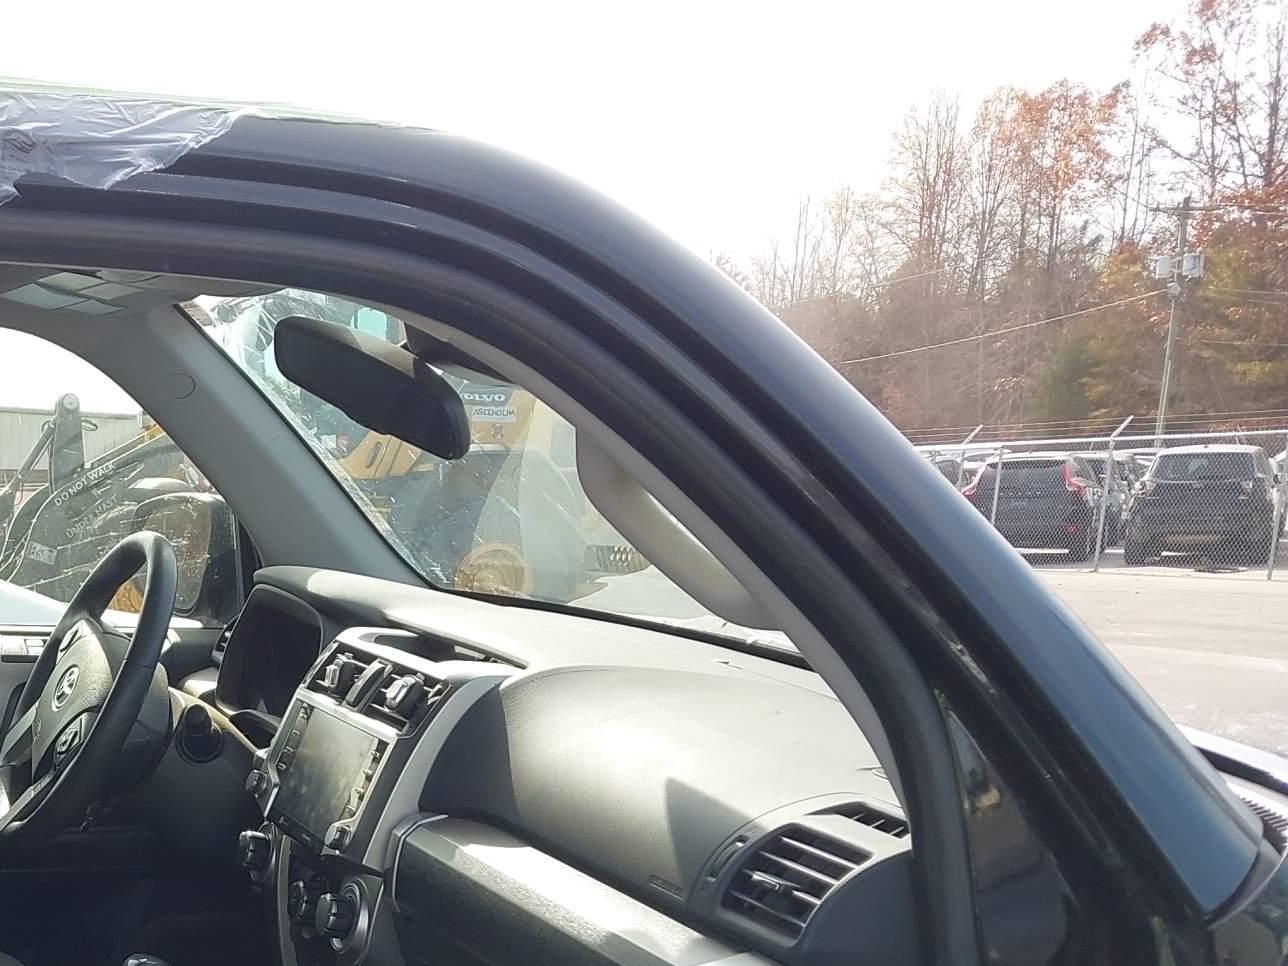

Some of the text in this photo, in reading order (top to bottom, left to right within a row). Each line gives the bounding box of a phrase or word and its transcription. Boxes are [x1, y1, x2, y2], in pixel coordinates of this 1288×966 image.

[472, 407, 516, 417] ASCENDUM
[54, 463, 116, 506] DO NOT WALK
